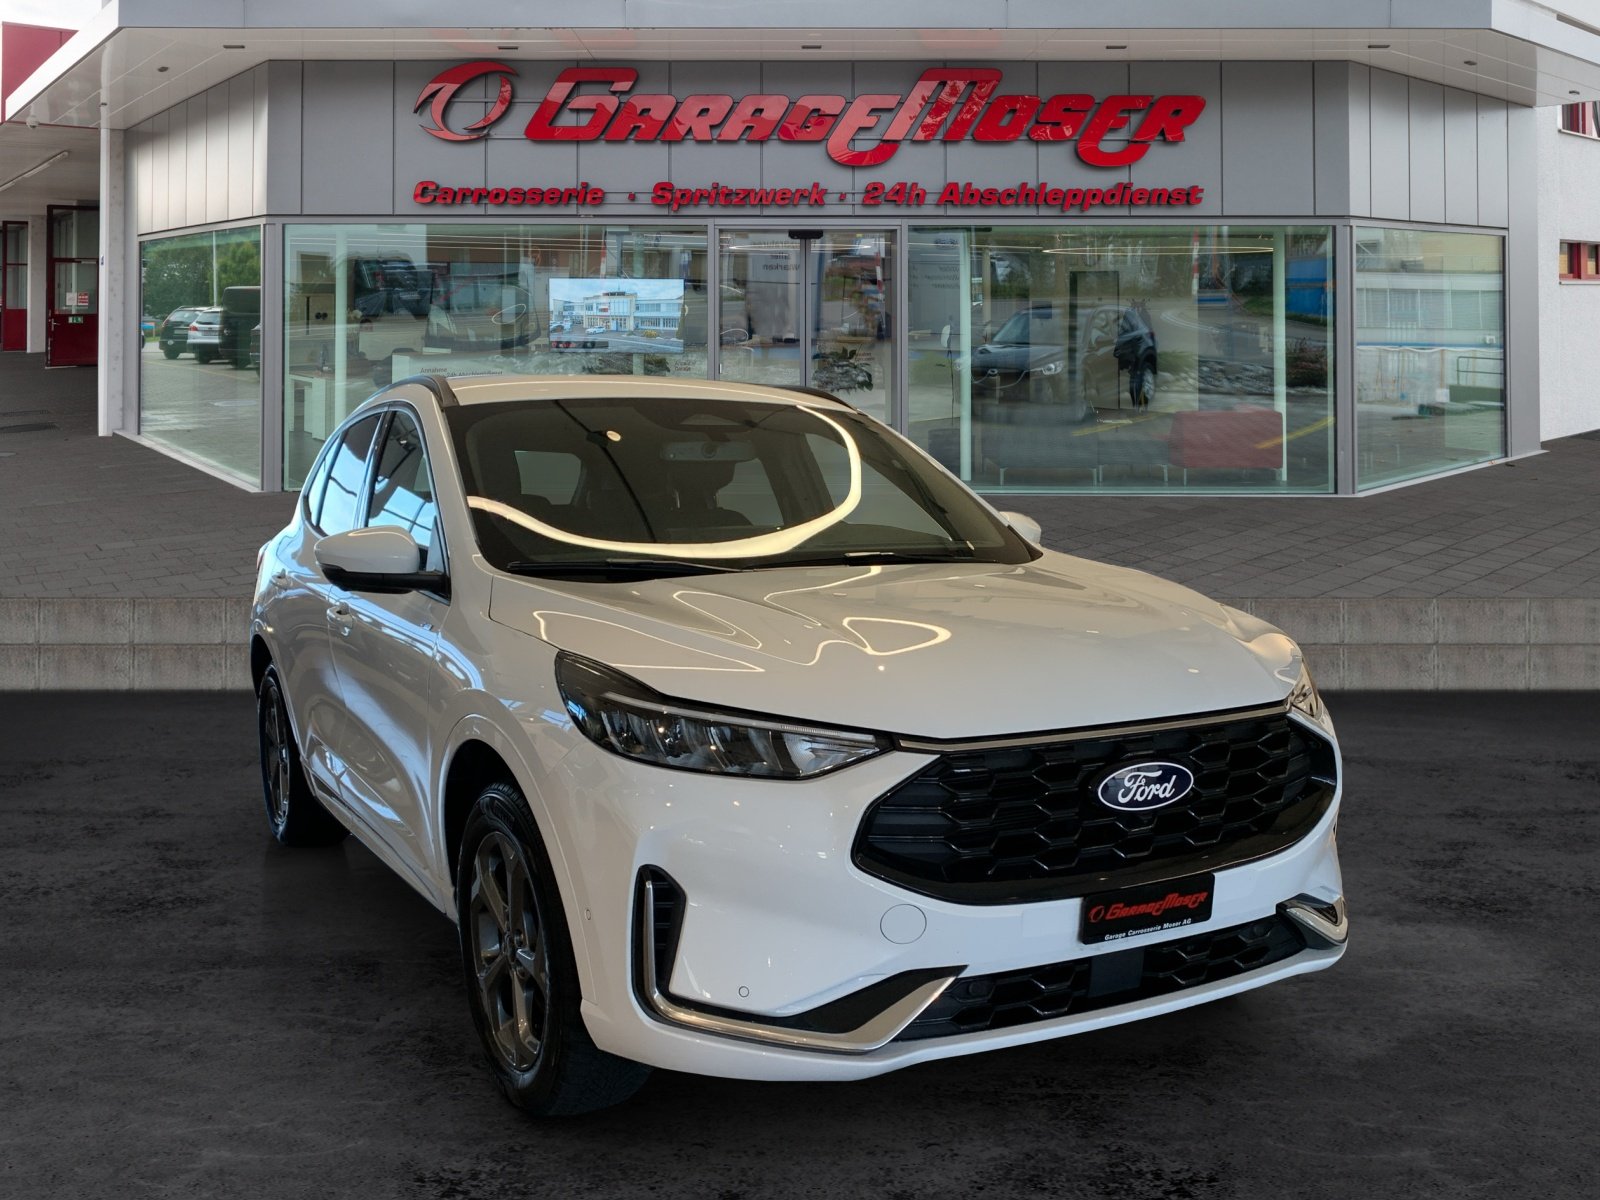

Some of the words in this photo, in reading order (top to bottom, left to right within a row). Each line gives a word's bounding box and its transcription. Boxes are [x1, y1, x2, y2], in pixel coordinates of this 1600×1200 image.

[413, 181, 604, 205] Carrosserie
[651, 181, 825, 211] Spritzwerk
[862, 182, 926, 205] 24h
[937, 182, 1204, 211] Abschleppdienst
[1118, 770, 1177, 804] Ford
[1104, 931, 1126, 941] Garage
[1127, 925, 1161, 937] Carrosserie
[1162, 920, 1182, 930] Moser
[1182, 918, 1192, 926] AG
